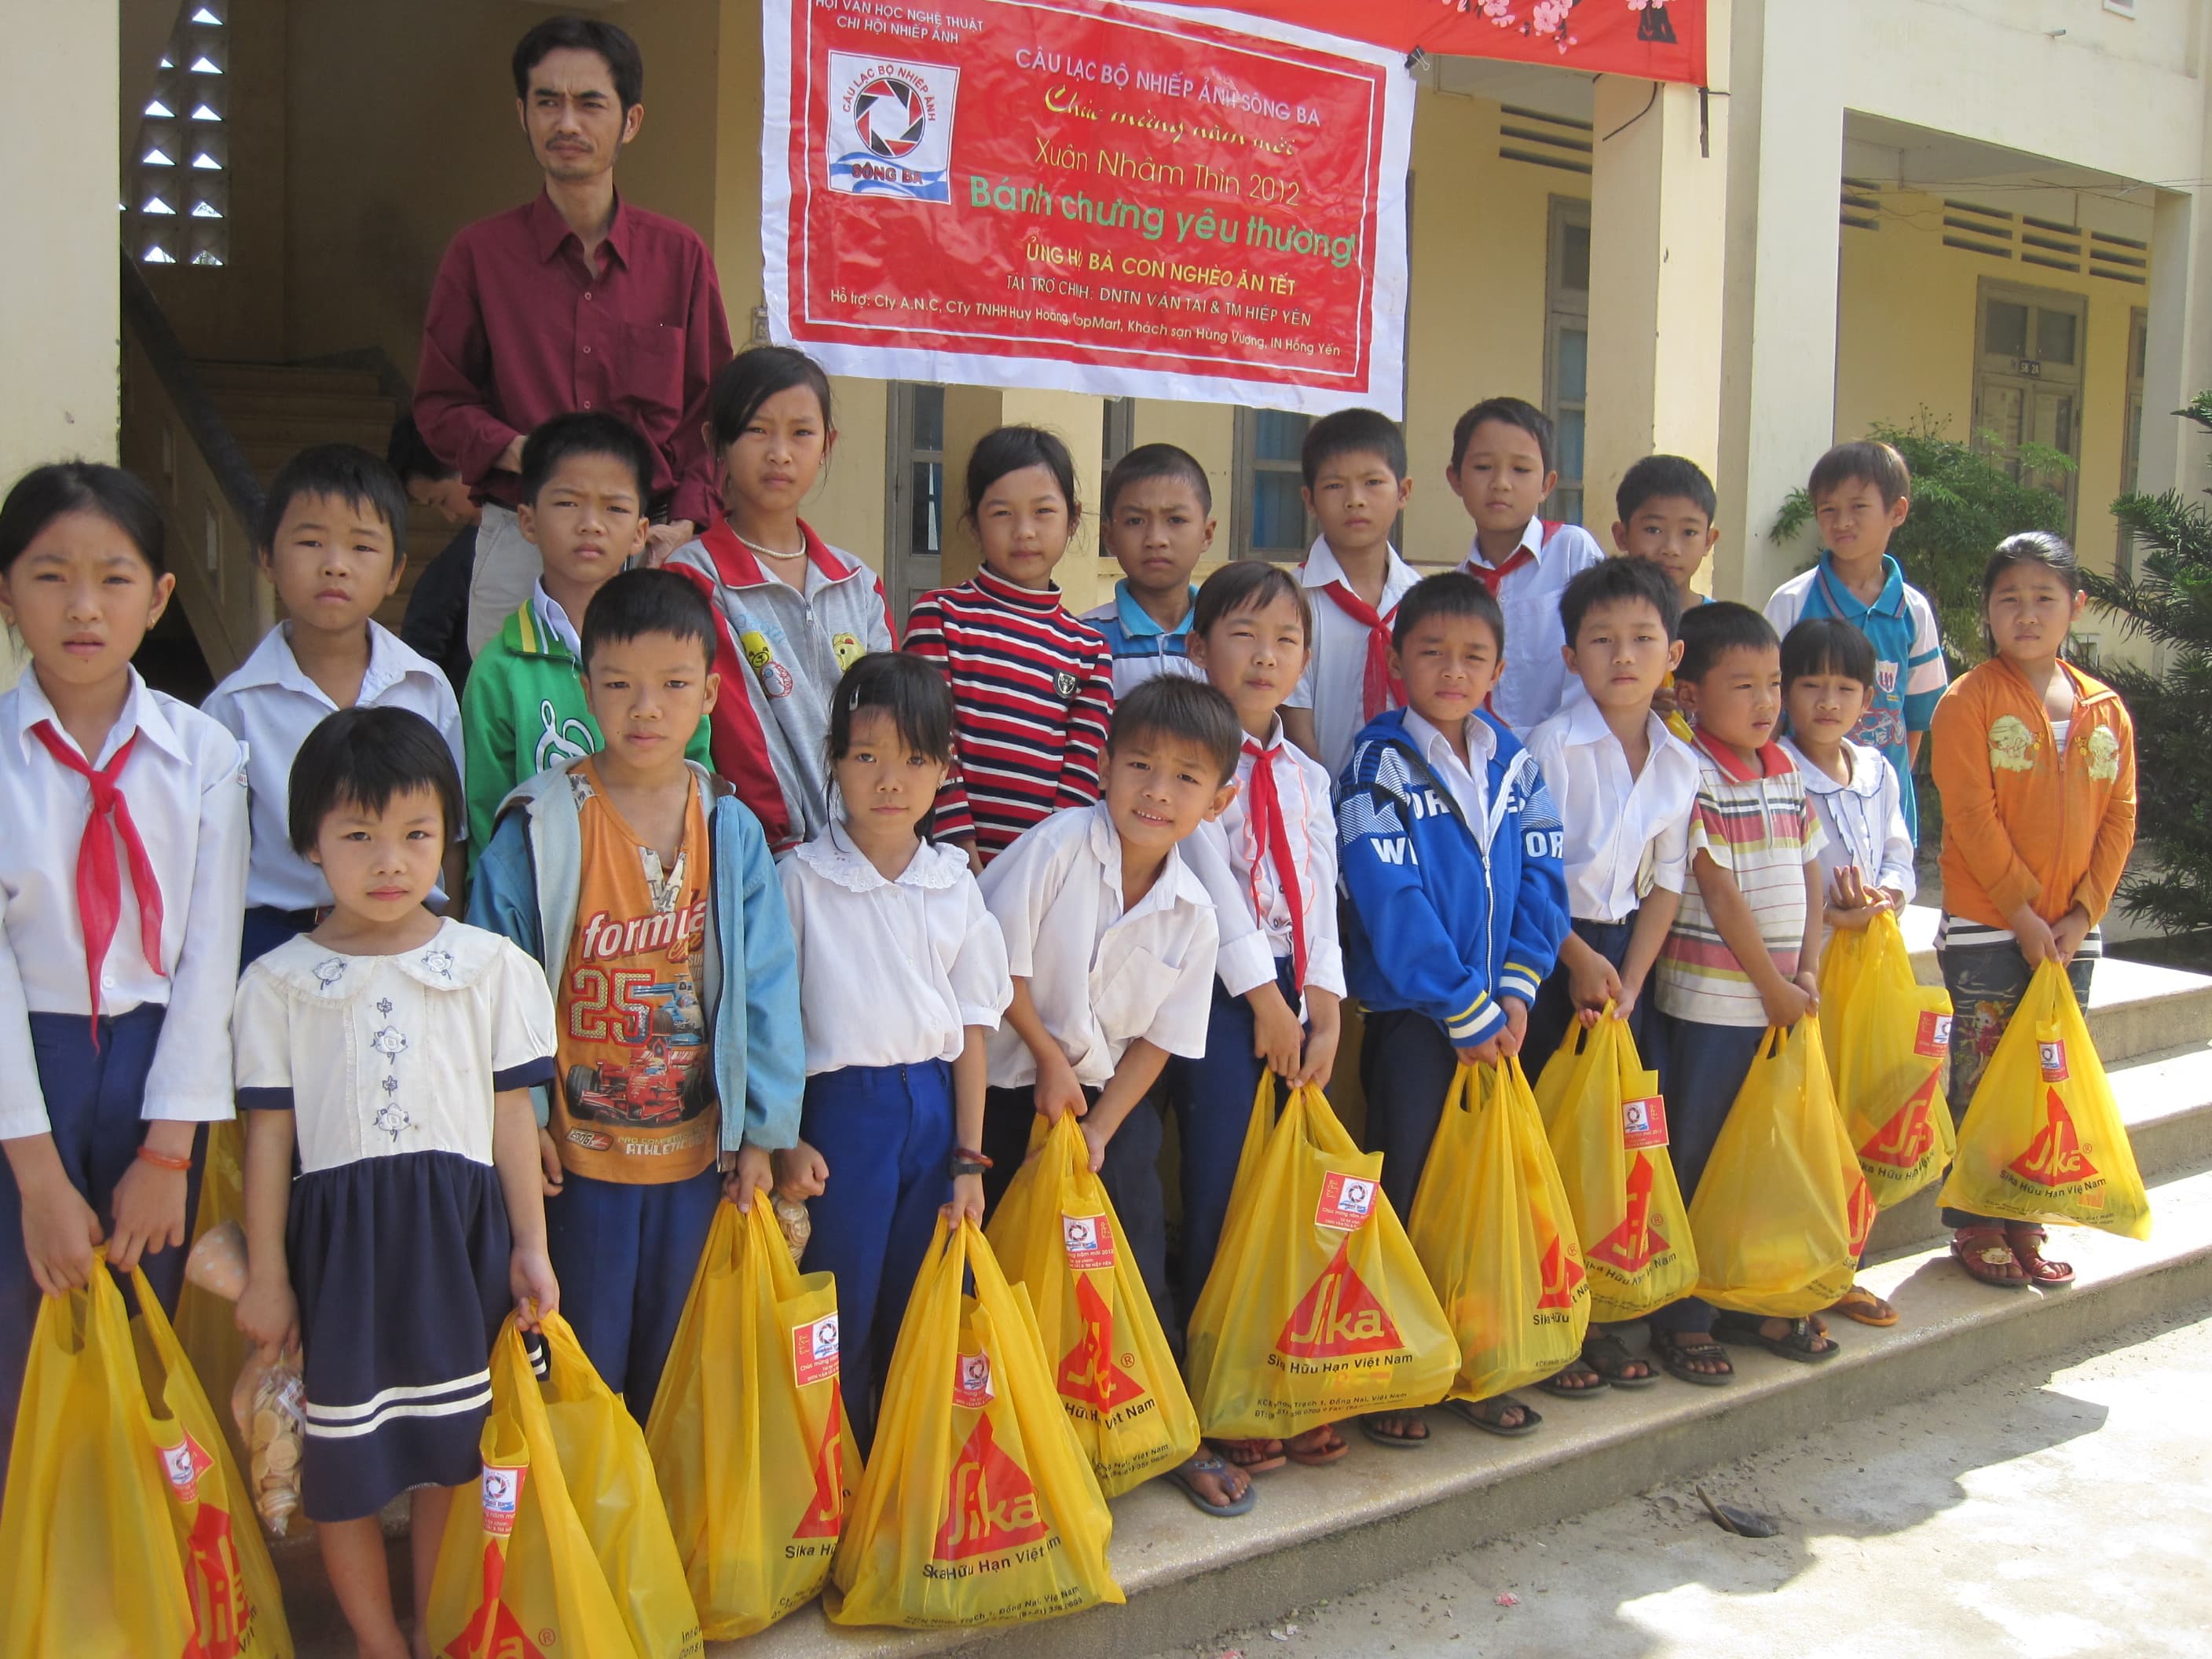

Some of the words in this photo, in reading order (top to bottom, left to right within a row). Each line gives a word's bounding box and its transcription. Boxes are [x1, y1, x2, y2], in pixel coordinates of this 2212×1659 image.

[837, 16, 860, 29] CHI
[864, 18, 886, 35] HỘI
[890, 21, 928, 39] NHIẾP
[932, 24, 959, 44] ẢNH
[874, 5, 903, 18] HỌC
[907, 9, 943, 25] NGHỆ
[946, 15, 983, 33] THUẬT
[854, 68, 875, 88] LẠC
[877, 64, 894, 77] BỘ
[1016, 46, 1060, 73] CÂU
[1066, 57, 1097, 82] LẠC
[1101, 63, 1129, 90] BỘ
[1136, 71, 1194, 98] NHIẾP
[1198, 76, 1236, 108] ẢNH
[1241, 92, 1291, 120] SÔNG
[1297, 106, 1320, 126] BA
[851, 162, 896, 181] SÔNG
[901, 169, 924, 185] BA
[1035, 137, 1089, 172] Xuân
[1098, 149, 1185, 186] Nhâm
[1194, 163, 1240, 196] Thìn
[1249, 174, 1300, 207] 2012
[970, 175, 1052, 216] Bánh
[1062, 191, 1164, 240] chưng
[1177, 208, 1239, 243] yêu
[1246, 214, 1357, 268] thương
[1026, 236, 1064, 265] ỦNG
[1121, 257, 1165, 278] CON
[1170, 264, 1233, 287] NGHÈO
[1236, 269, 1264, 291] ĂN
[1269, 272, 1295, 295] TẾT
[1031, 276, 1055, 295] TRỢ
[1100, 287, 1141, 305] DNTN
[1210, 301, 1220, 314] &
[1225, 302, 1241, 317] TM
[874, 295, 896, 310] Cty
[900, 297, 942, 313] A.N.C,
[946, 301, 971, 317] CTy
[976, 303, 1007, 317] TNHH
[1009, 306, 1032, 321] Huy
[1128, 320, 1167, 336] Khách
[1170, 327, 1192, 340] sạn
[1196, 327, 1228, 343] Hùng
[1271, 337, 1282, 350] IN
[569, 965, 656, 1048] 25
[1999, 1169, 2018, 1186] Sika
[2084, 1178, 2107, 1191] Nam
[1654, 1253, 1676, 1269] Nam
[1290, 1362, 1318, 1375] Hữu
[1323, 1361, 1349, 1373] Hạn
[1354, 1356, 1379, 1368] Việt
[1384, 1354, 1413, 1366] Nam
[1126, 1398, 1155, 1419] Nam
[1151, 1444, 1169, 1455] Nam
[947, 1462, 1042, 1546] Sika
[785, 1544, 815, 1559] Sika
[979, 1558, 1011, 1573] Hạn
[1016, 1547, 1045, 1563] Việt
[1061, 1585, 1079, 1599] Nam
